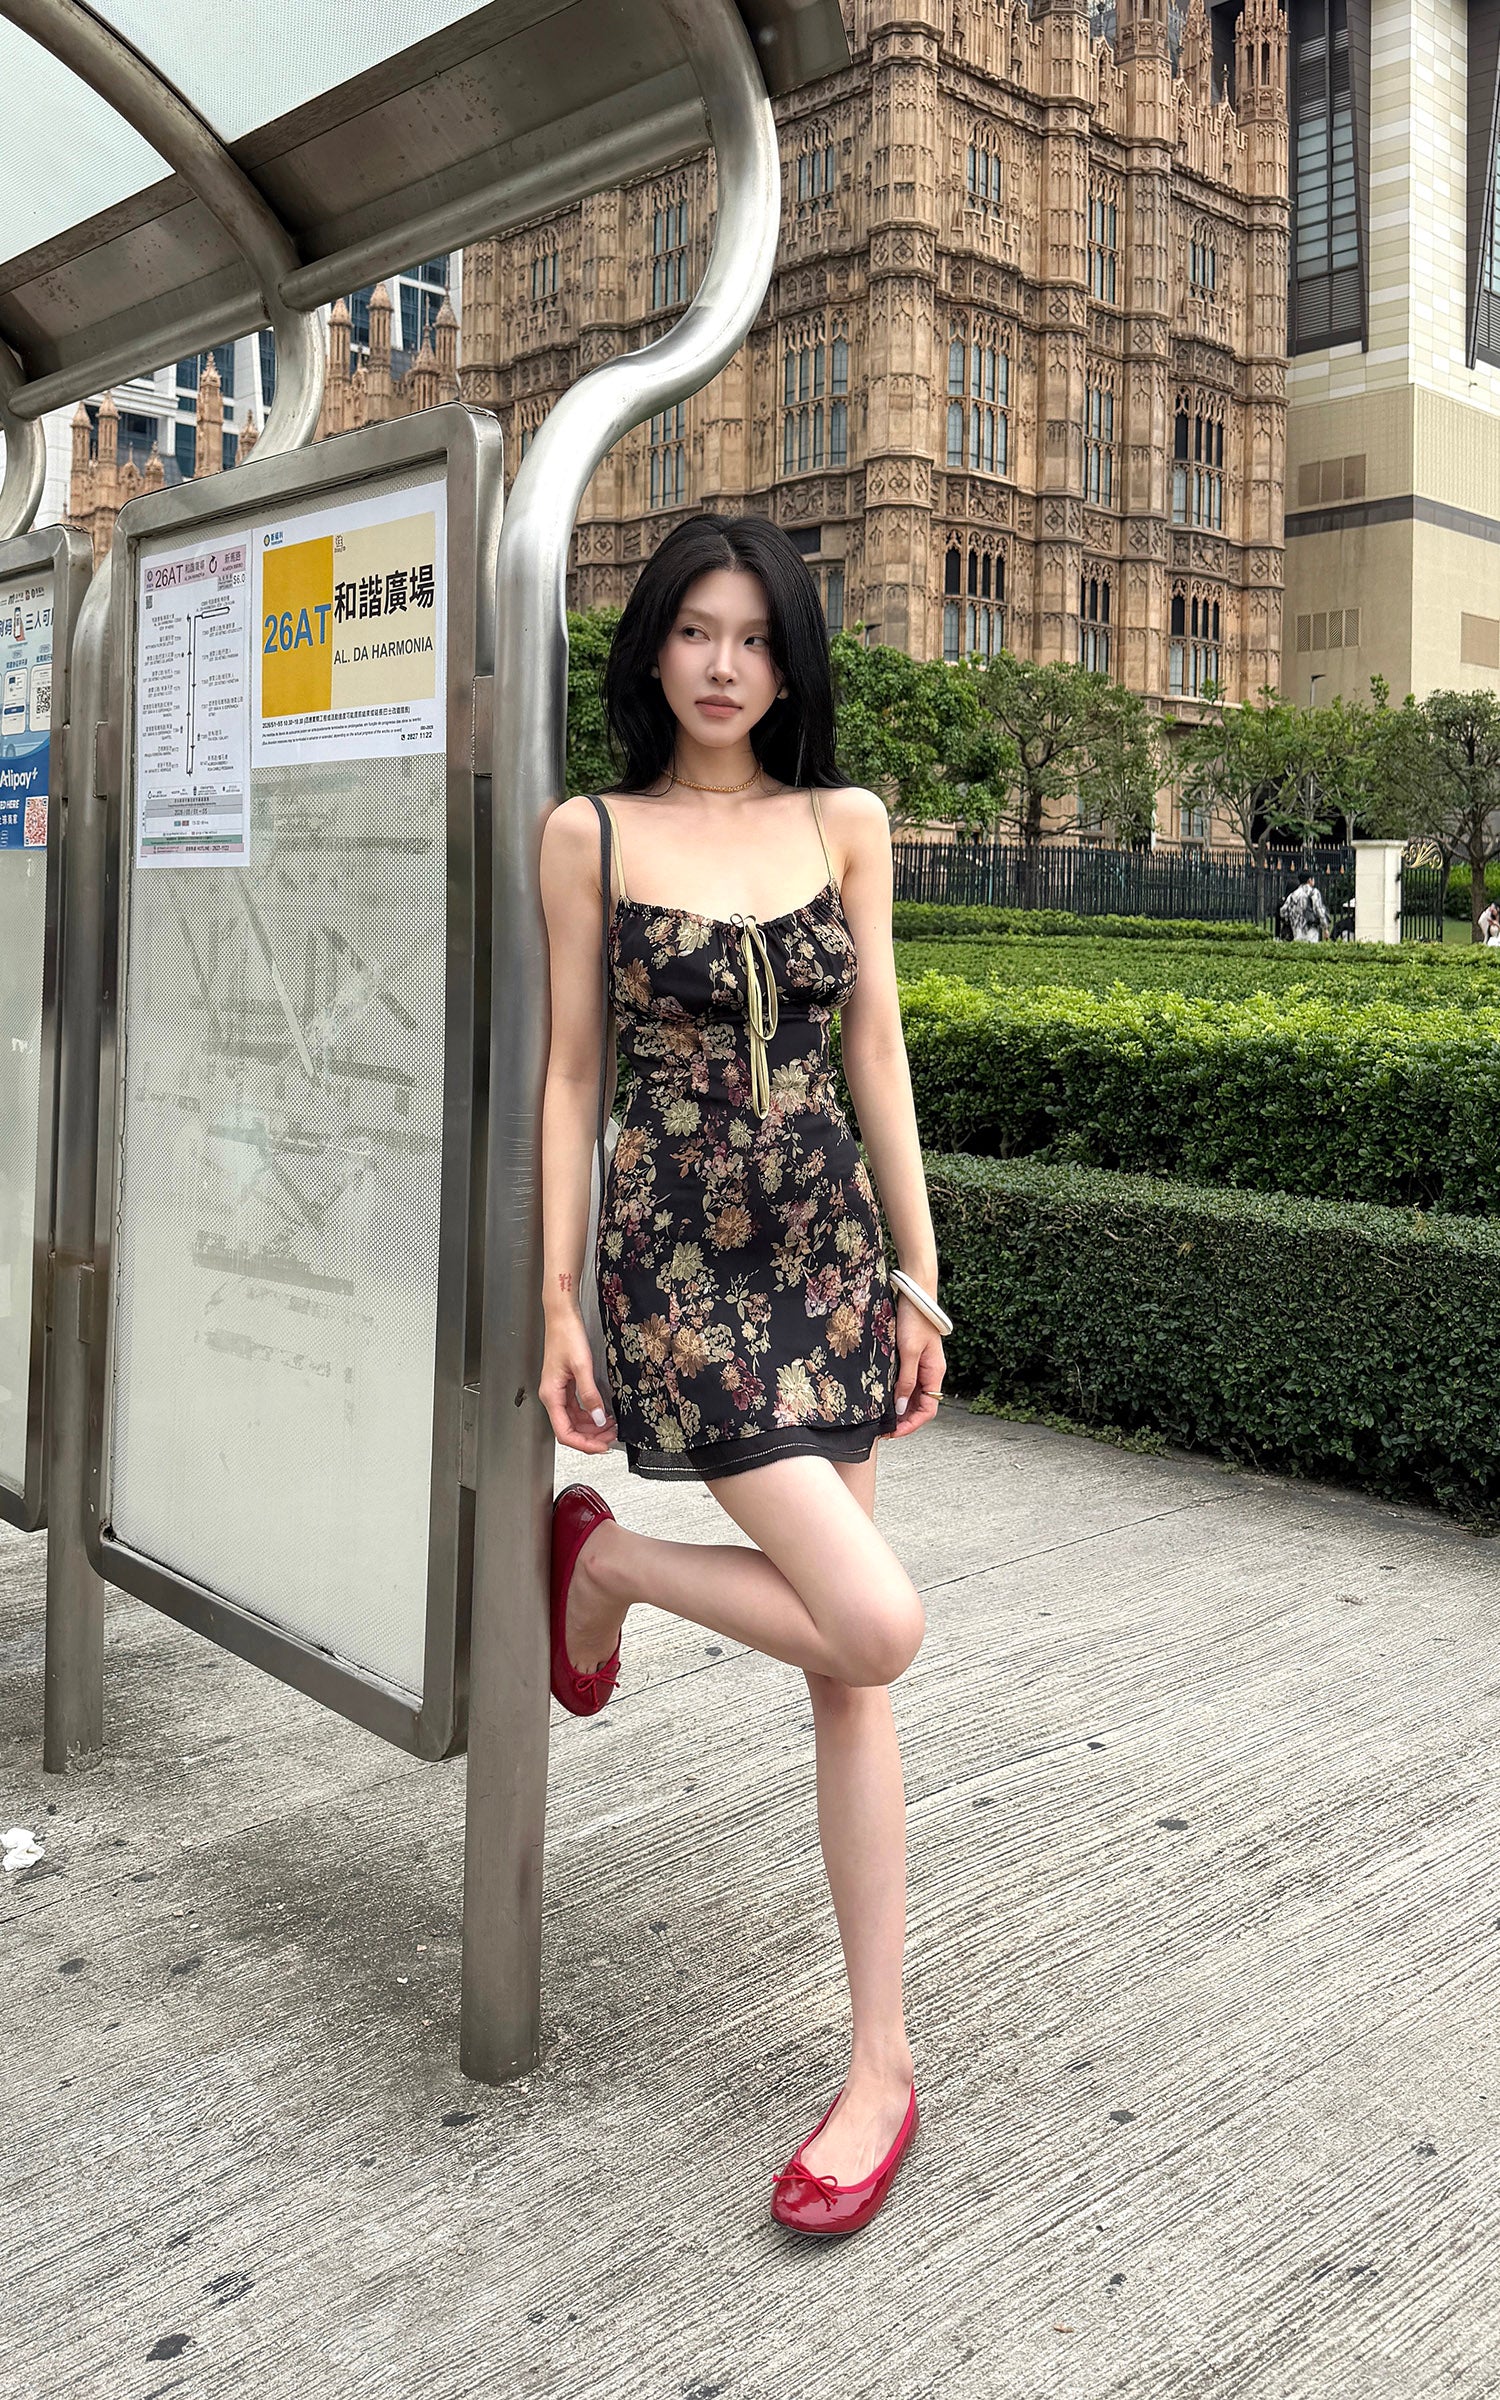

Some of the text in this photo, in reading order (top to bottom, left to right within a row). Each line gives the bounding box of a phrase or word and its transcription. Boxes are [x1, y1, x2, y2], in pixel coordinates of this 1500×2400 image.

[155, 564, 183, 589] 26AT
[334, 564, 435, 624] 和諧廣場
[264, 603, 332, 654] 26AT
[333, 636, 433, 665] AL. DA HARMONIA
